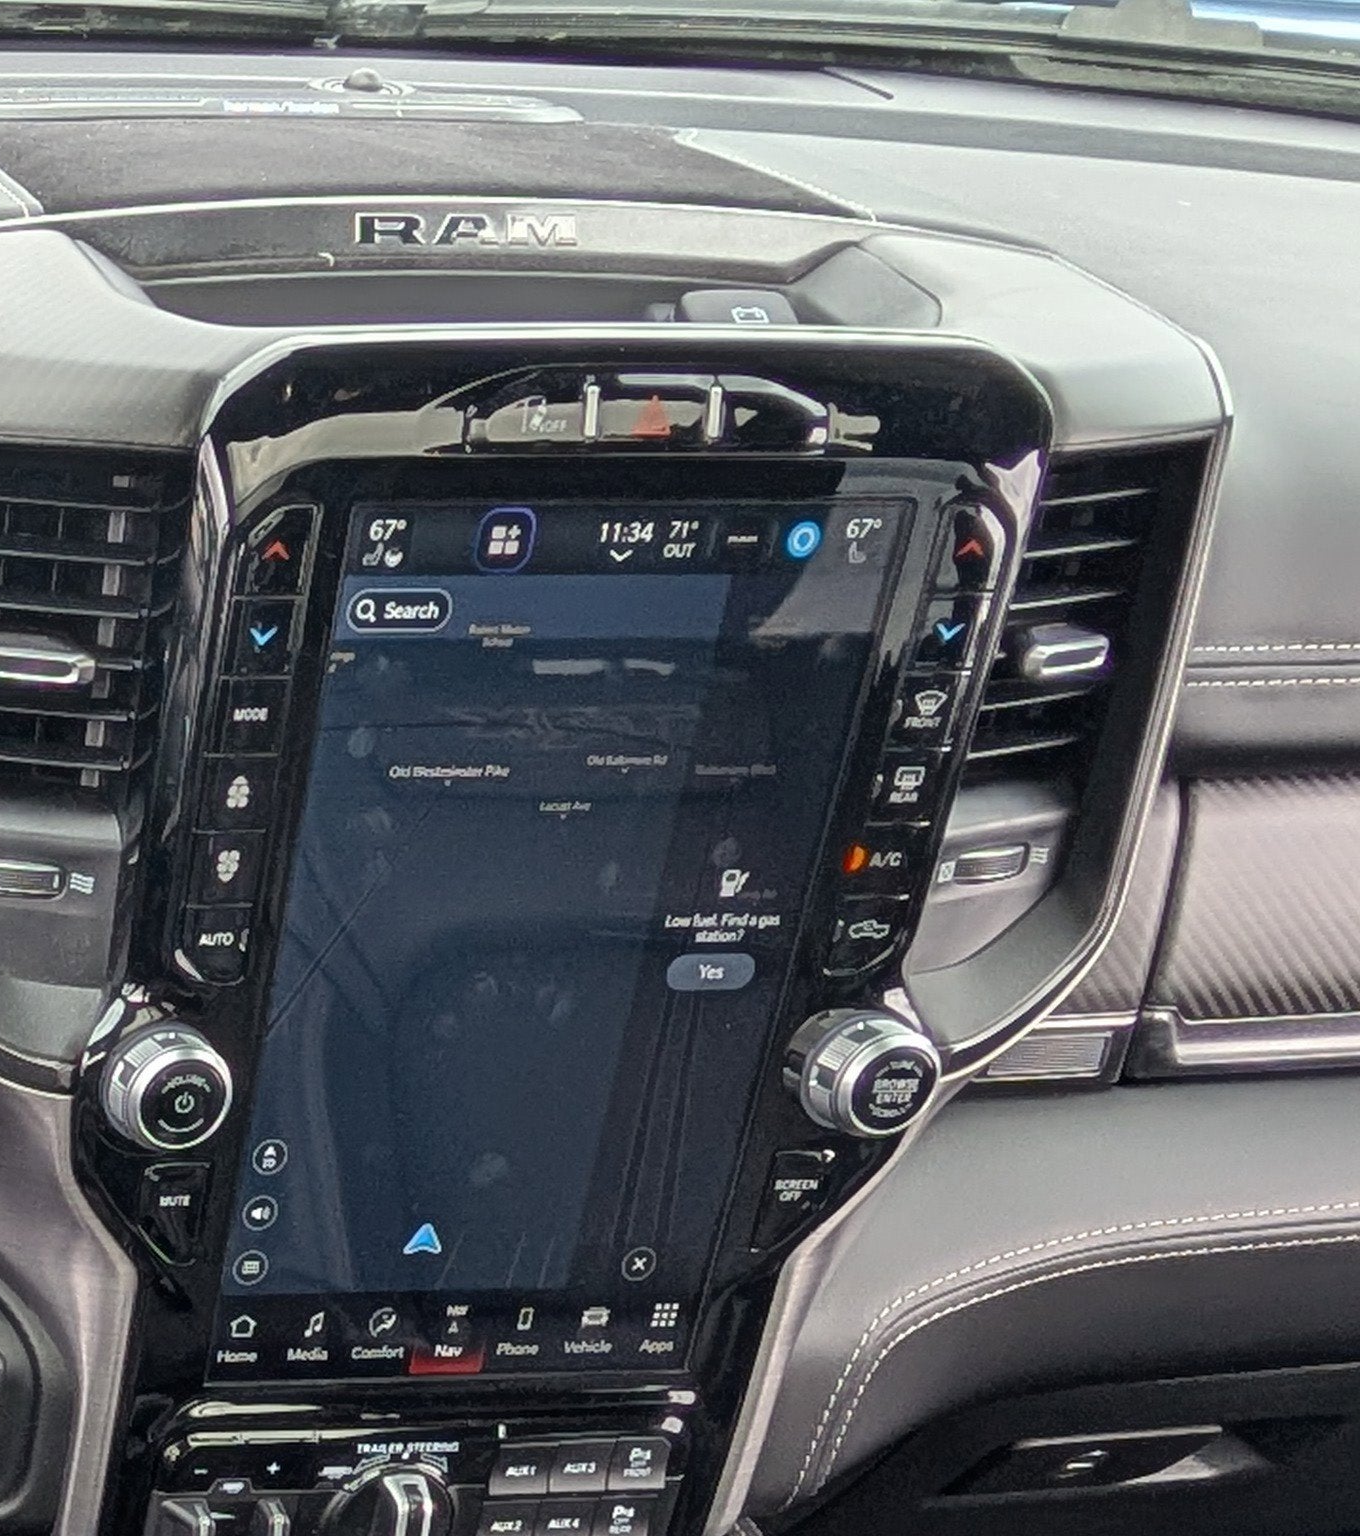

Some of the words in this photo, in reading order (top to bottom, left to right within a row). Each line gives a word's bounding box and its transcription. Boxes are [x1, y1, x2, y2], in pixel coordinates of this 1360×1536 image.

[355, 212, 578, 247] RAM
[600, 521, 654, 543] 11:34
[663, 542, 696, 558] OUT
[383, 600, 440, 620] Search
[233, 708, 269, 722] MODE
[904, 716, 942, 728] FRONT
[389, 765, 411, 778] Old
[889, 792, 919, 803] REAR
[869, 851, 902, 867] A/C
[664, 914, 690, 928] Low
[720, 913, 749, 928] Find
[749, 917, 757, 927] a
[758, 916, 780, 930] gas
[198, 932, 234, 947] AUTO
[694, 928, 746, 943] station?
[698, 964, 724, 980] Yes
[774, 1179, 819, 1191] SCREEN
[159, 1195, 191, 1207] MUTE
[779, 1190, 803, 1202] OFF
[351, 1346, 405, 1360] Comfort
[434, 1344, 463, 1357] Nav
[496, 1342, 540, 1355] Phone
[564, 1340, 613, 1354] Vehicle
[639, 1339, 674, 1353] Apps
[217, 1351, 258, 1363] Home
[286, 1347, 329, 1361] Media
